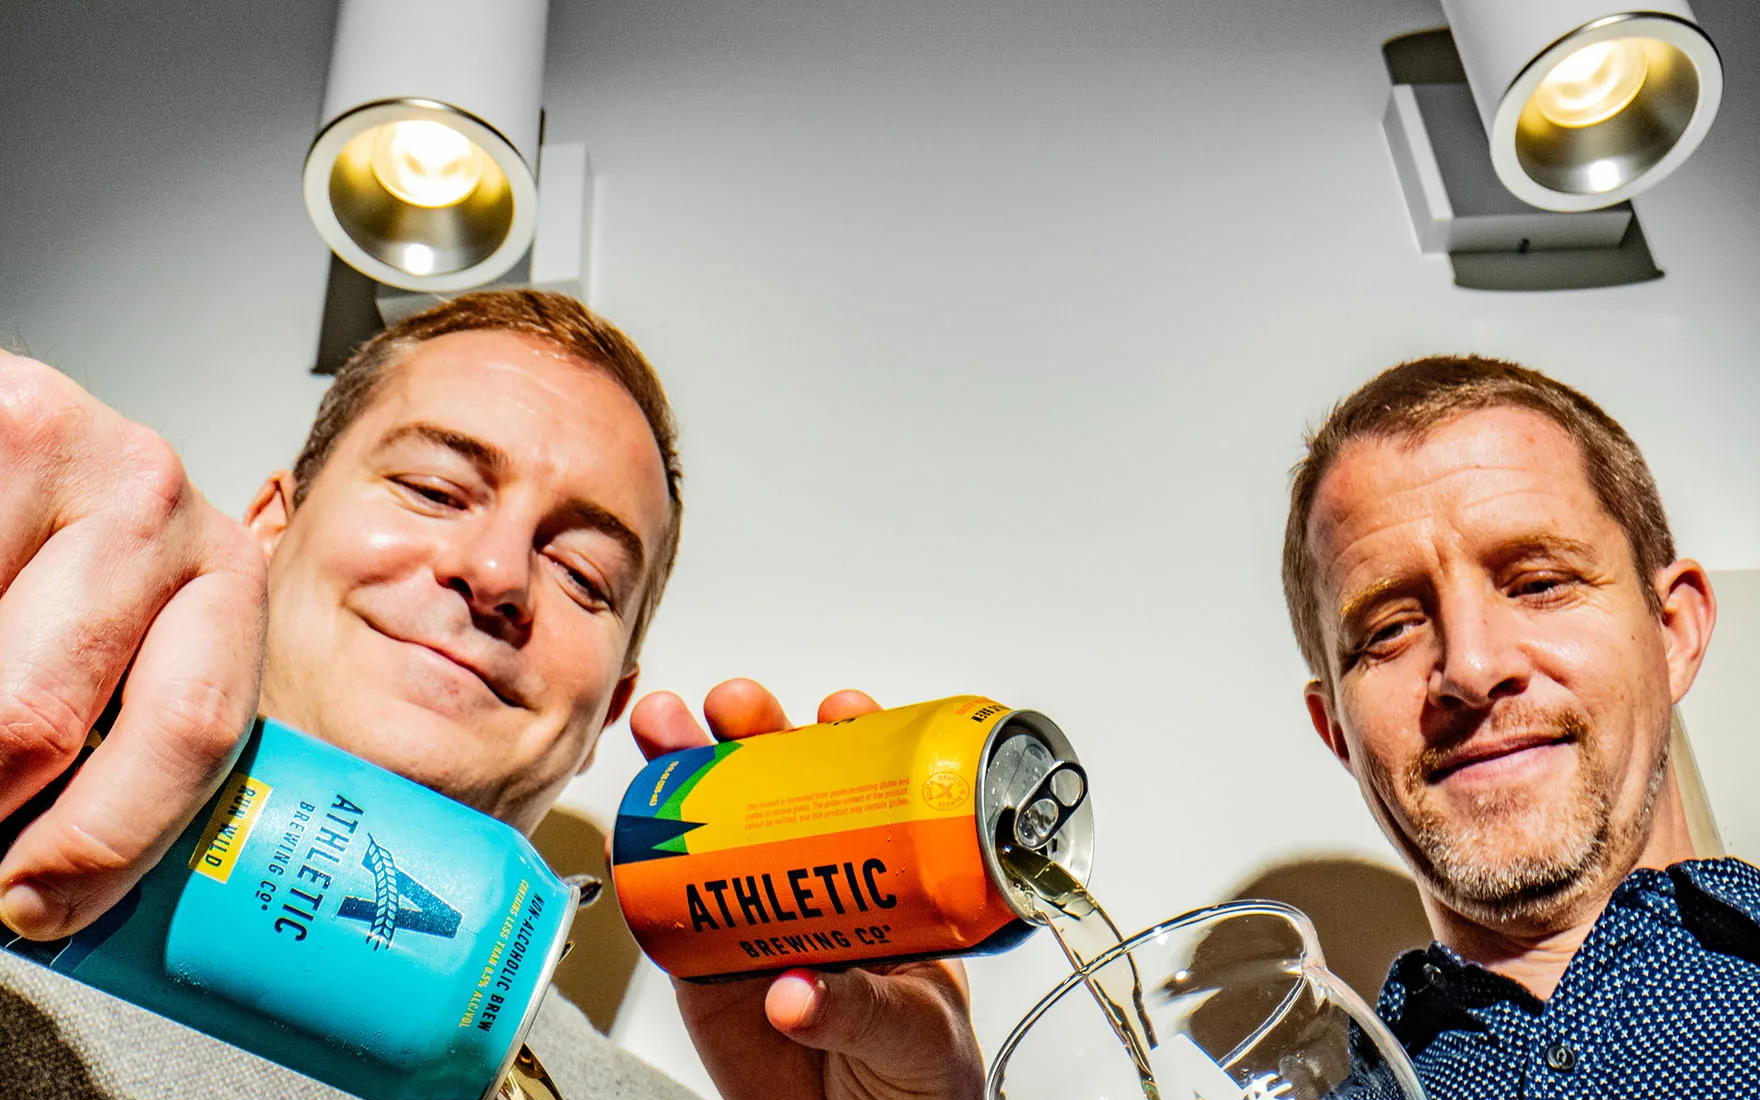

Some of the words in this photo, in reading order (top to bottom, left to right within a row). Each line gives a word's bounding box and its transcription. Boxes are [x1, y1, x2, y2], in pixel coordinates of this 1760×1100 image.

[227, 783, 257, 820] RUN
[205, 821, 238, 867] WILD
[268, 800, 316, 876] BREWING
[274, 793, 364, 941] ATHLETIC
[509, 878, 529, 917] CONTAINS
[685, 857, 898, 933] ATHLETIC
[496, 891, 545, 991] NON-ALCOHOLIC
[500, 915, 515, 940] LESS
[738, 929, 852, 958] BREWING
[488, 940, 506, 967] THAN
[478, 966, 494, 988] 0.5%
[458, 989, 483, 1028] ALC/VOL
[477, 993, 505, 1032] BREW
